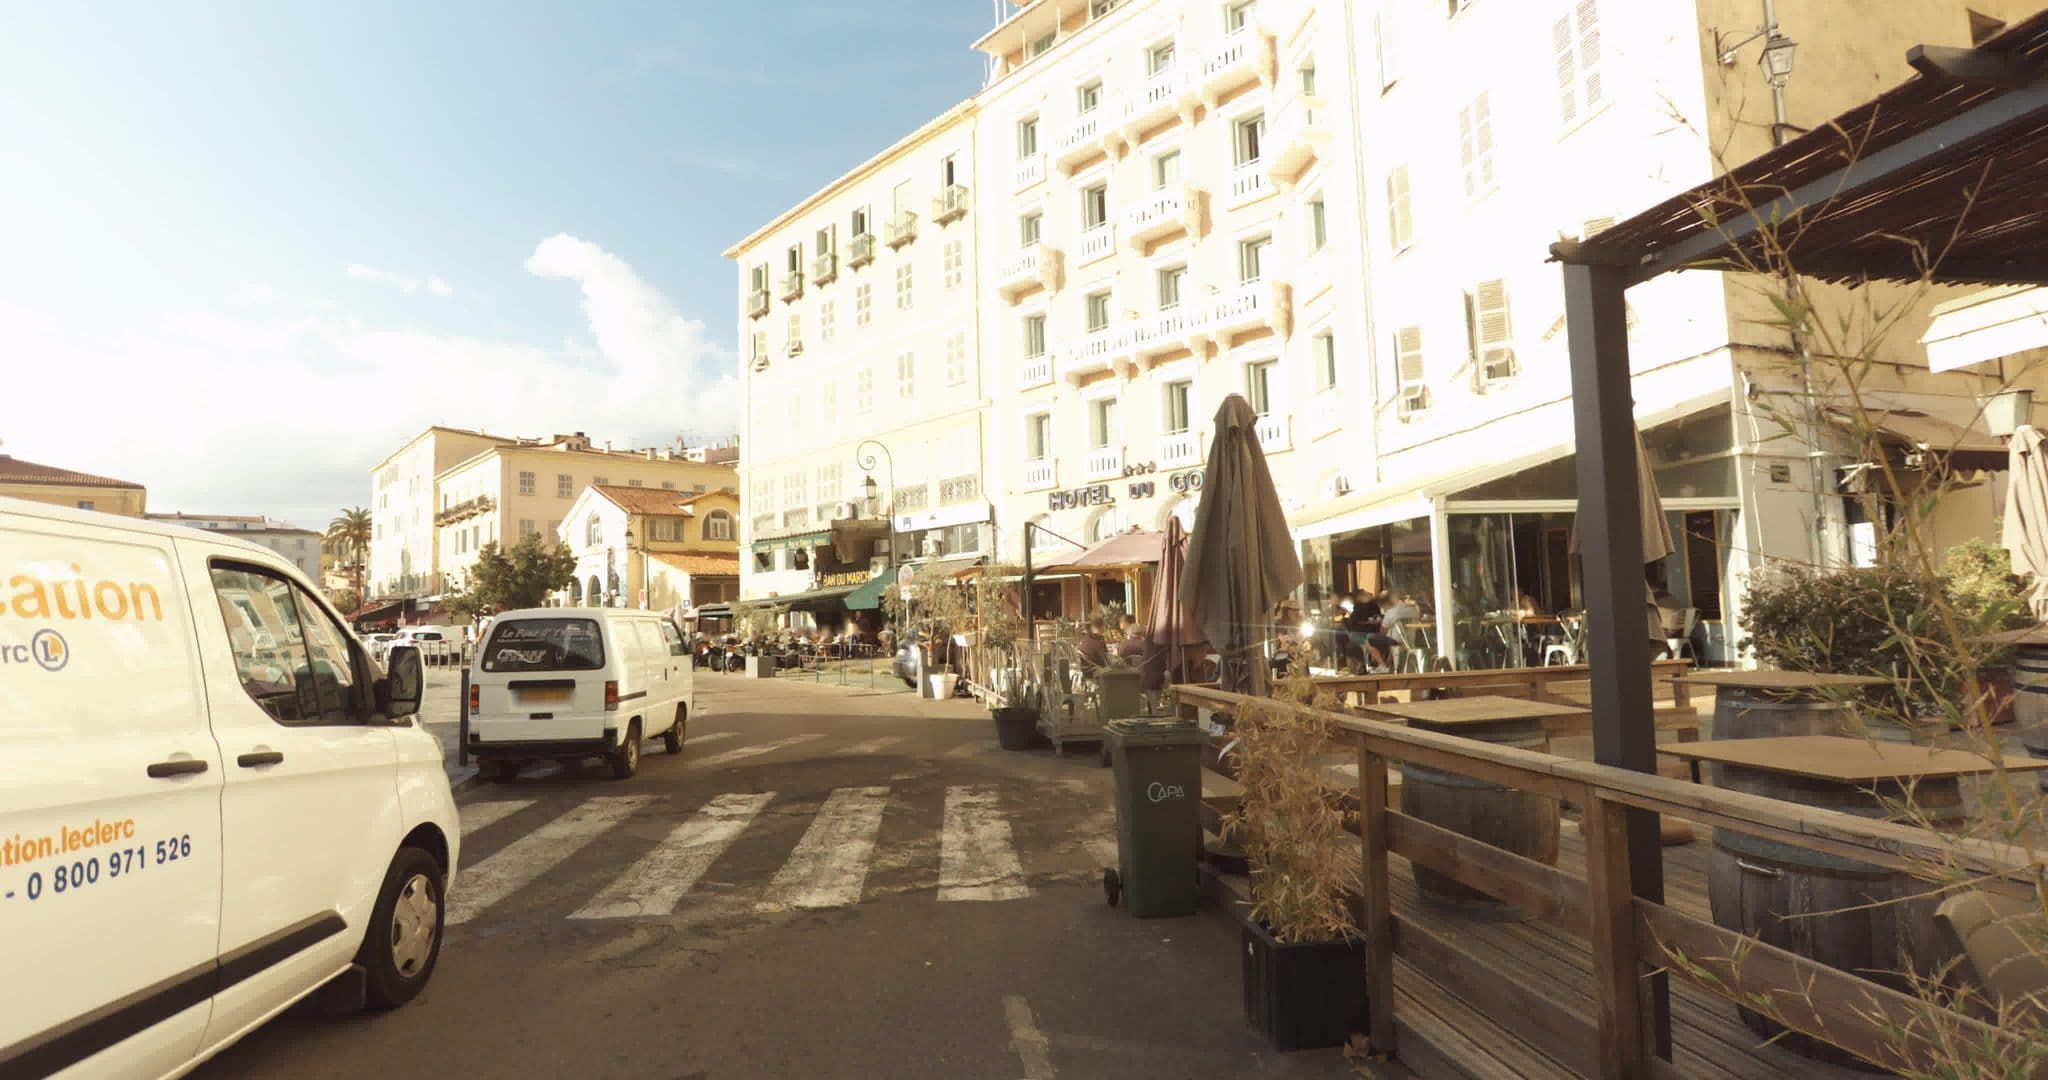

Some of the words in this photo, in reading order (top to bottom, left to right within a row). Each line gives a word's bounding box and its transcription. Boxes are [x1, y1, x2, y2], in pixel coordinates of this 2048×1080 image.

[1048, 484, 1116, 511] HOTEL
[0, 562, 164, 622] ation
[822, 574, 836, 586] BAR
[1147, 781, 1185, 802] CAPA
[0, 818, 135, 867] tion.leclerc
[27, 871, 43, 900] 0
[53, 857, 100, 893] 800
[109, 845, 145, 878] 971
[156, 834, 191, 865] 526
